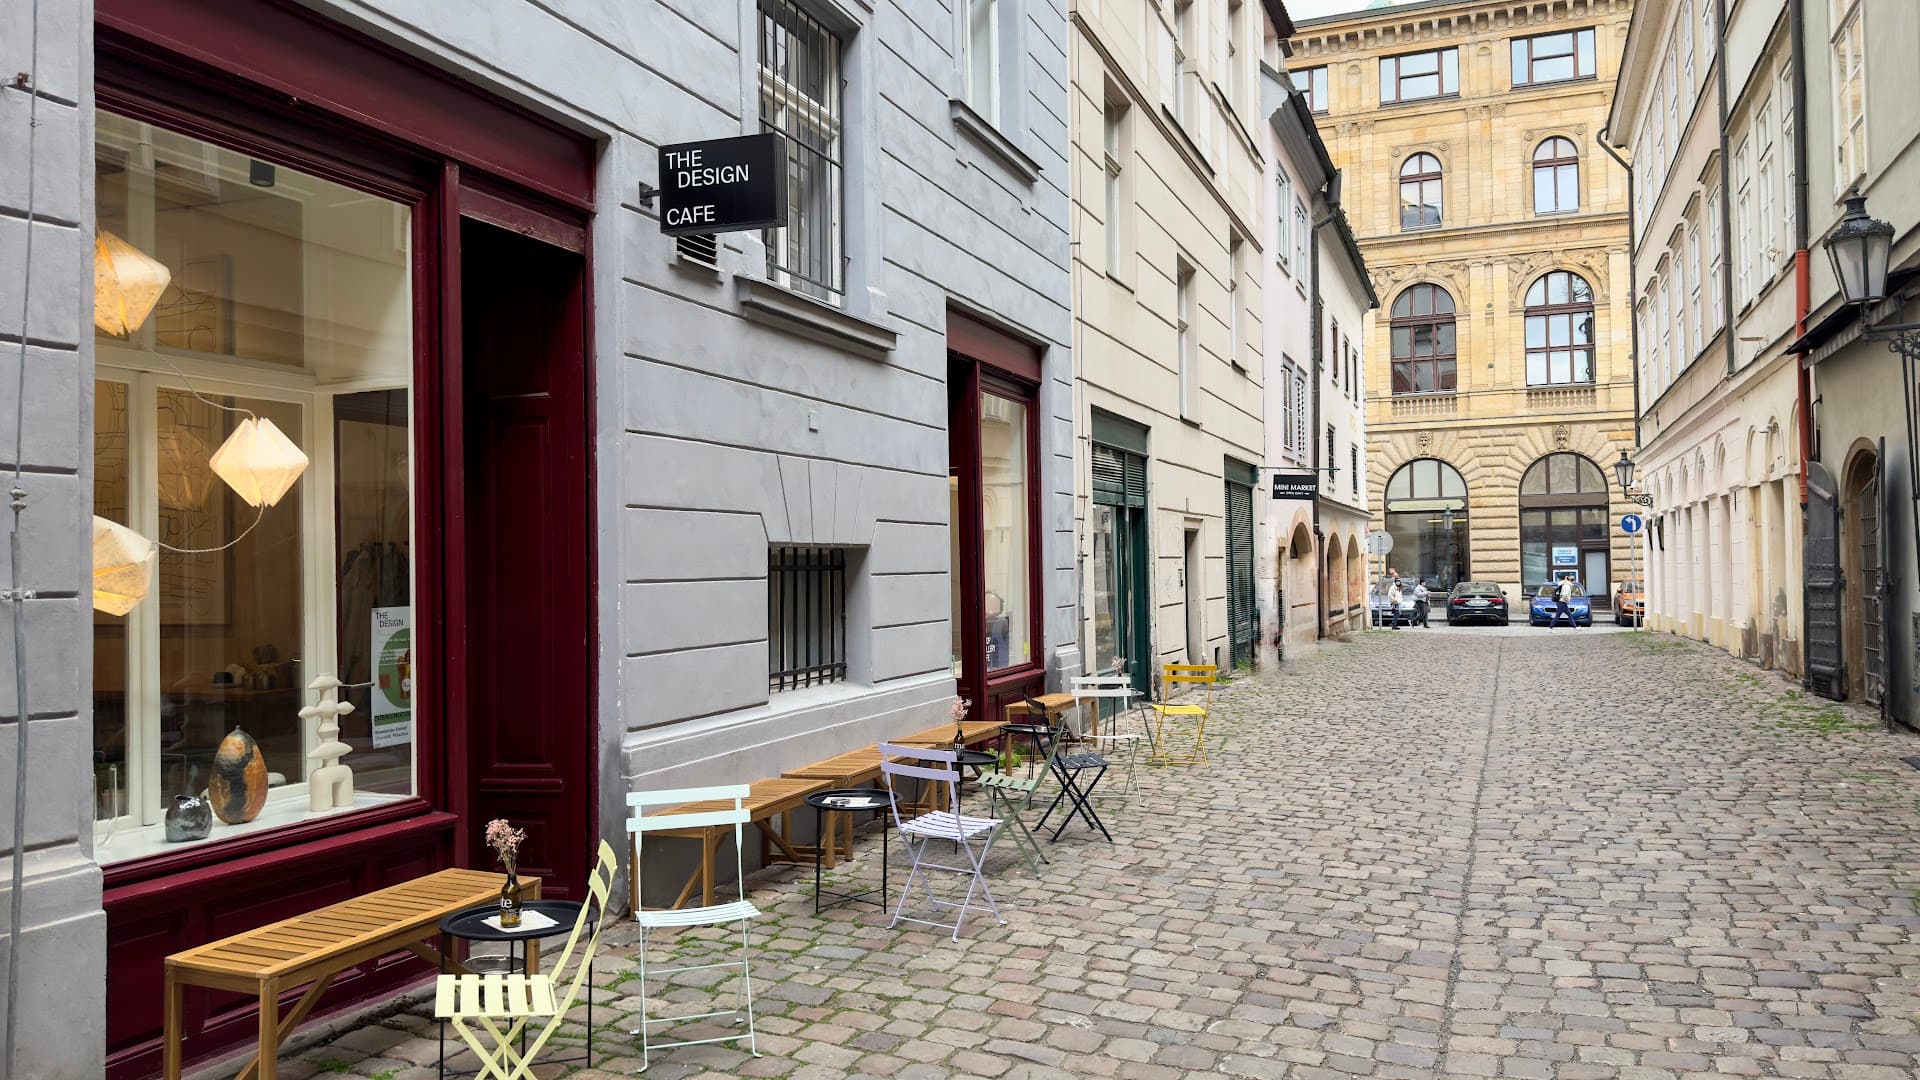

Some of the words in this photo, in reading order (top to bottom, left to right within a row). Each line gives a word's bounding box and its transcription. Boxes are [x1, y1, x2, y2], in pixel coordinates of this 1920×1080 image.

[665, 149, 702, 170] THE
[677, 164, 749, 188] DESIGN
[666, 205, 715, 225] CAFE
[376, 611, 388, 620] THE
[379, 618, 404, 628] DESIGN
[986, 645, 995, 653] LLERY
